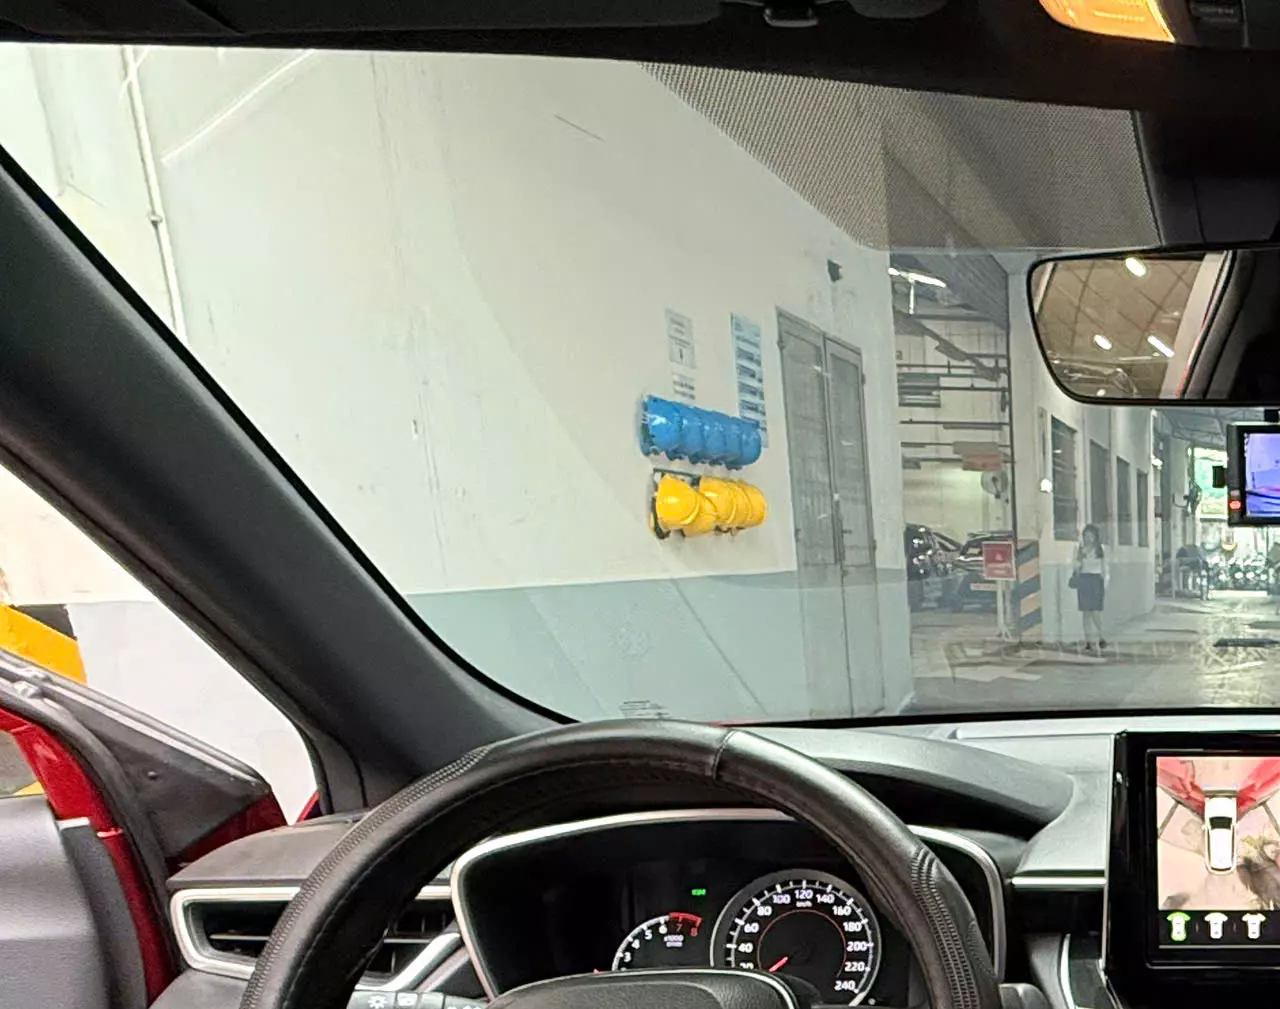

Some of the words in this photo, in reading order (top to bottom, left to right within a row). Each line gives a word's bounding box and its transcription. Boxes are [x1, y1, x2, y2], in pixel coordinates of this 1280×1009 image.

[773, 894, 791, 904] 100
[795, 890, 813, 899] 120
[816, 894, 835, 903] 140
[757, 906, 772, 916] 80
[832, 906, 852, 916] 160
[658, 924, 668, 934] 6
[676, 923, 683, 932] 7
[690, 927, 698, 937] 8
[744, 923, 759, 933] 60
[843, 922, 862, 932] 180
[644, 929, 653, 940] 5
[631, 939, 640, 949] 4
[738, 943, 753, 953] 40
[847, 942, 867, 952] 200
[623, 951, 632, 962] 3
[844, 962, 865, 972] 220
[834, 981, 856, 991] 240
